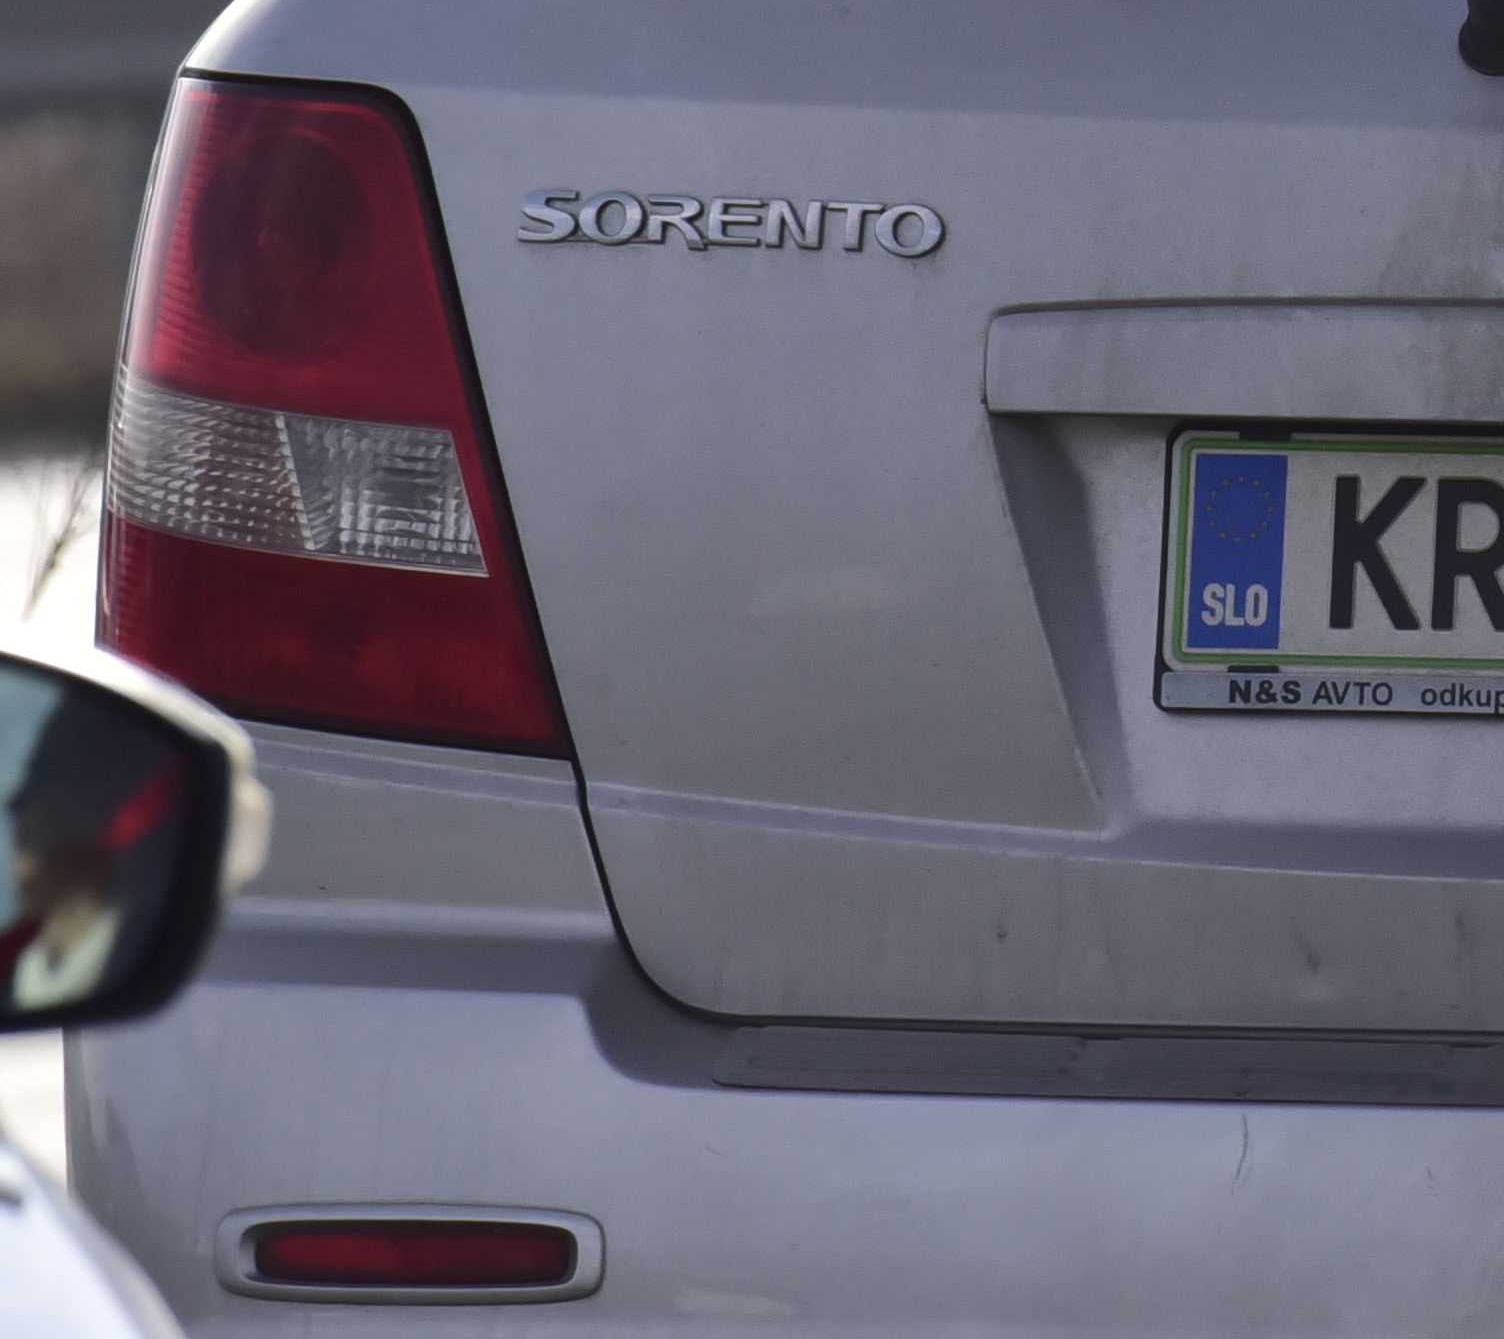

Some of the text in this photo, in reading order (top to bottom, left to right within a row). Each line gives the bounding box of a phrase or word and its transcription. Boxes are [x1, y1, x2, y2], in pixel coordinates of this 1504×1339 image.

[517, 189, 945, 258] SORENTO
[1199, 581, 1269, 630] SLO
[1228, 680, 1301, 706] N&S
[1311, 681, 1394, 707] AVTO
